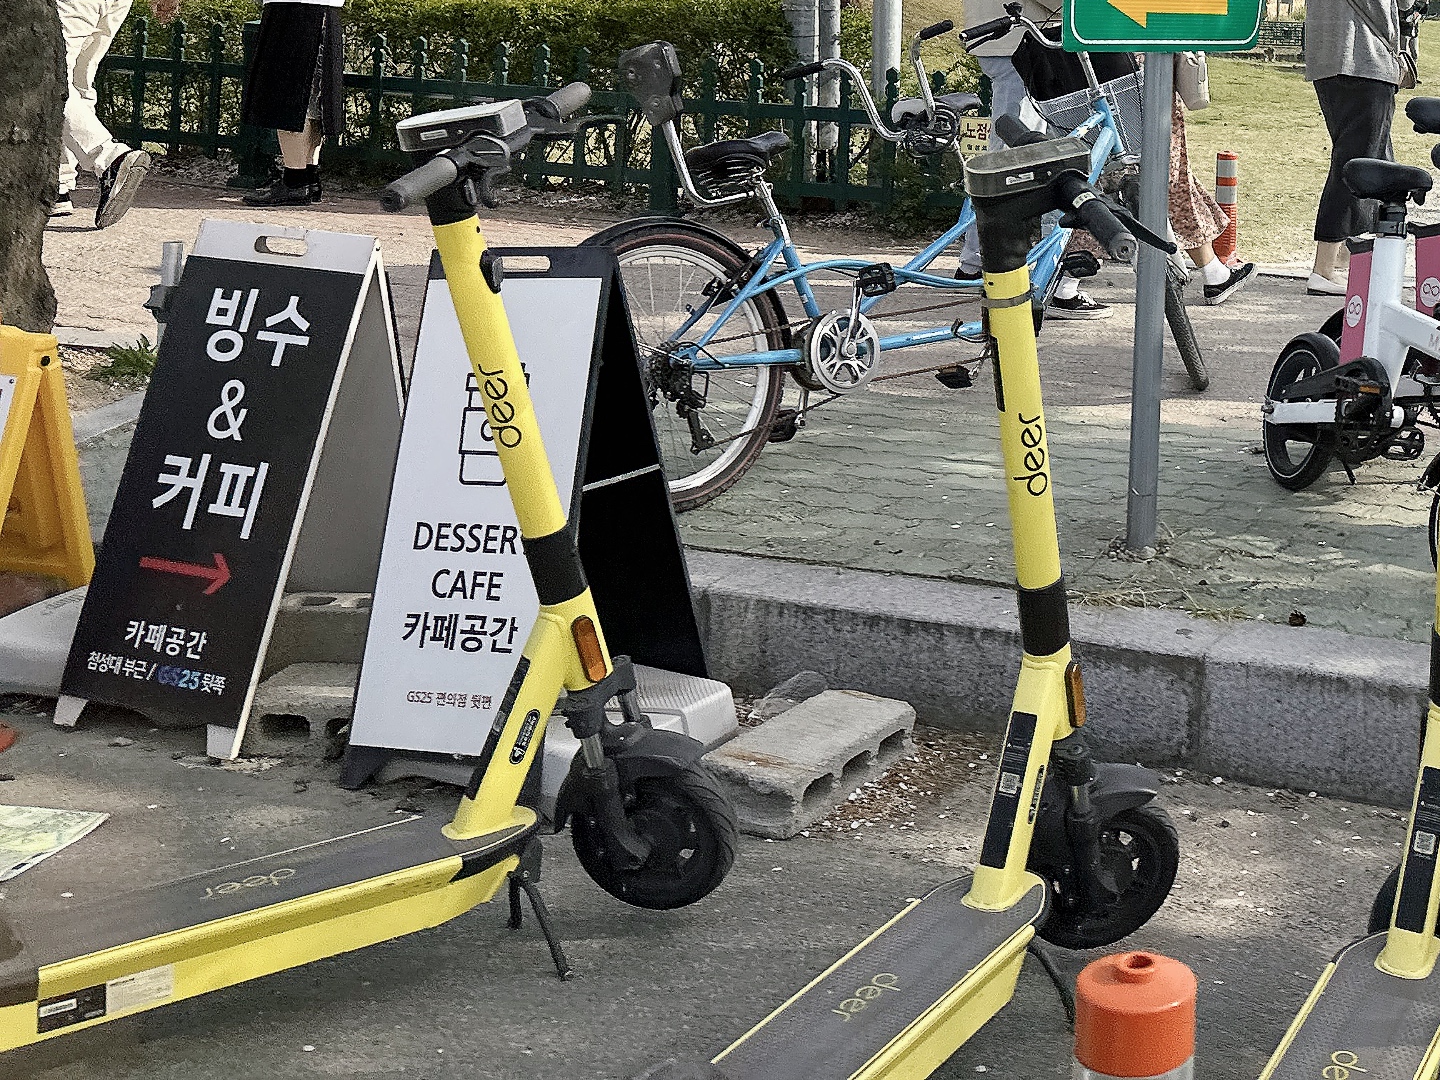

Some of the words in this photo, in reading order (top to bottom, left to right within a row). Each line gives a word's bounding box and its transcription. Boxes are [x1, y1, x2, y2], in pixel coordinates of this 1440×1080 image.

[204, 287, 312, 368] 빙수
[206, 378, 249, 441] &
[477, 363, 522, 449] deer
[1013, 411, 1049, 498] deer
[151, 452, 270, 540] 커피
[413, 520, 526, 556] DESSER
[430, 567, 504, 602] CAFE
[124, 620, 208, 660] 카페공간
[401, 610, 519, 655] 카페공간
[406, 690, 434, 704] GS25
[831, 972, 901, 1023] deer
[1322, 1050, 1369, 1080] de
